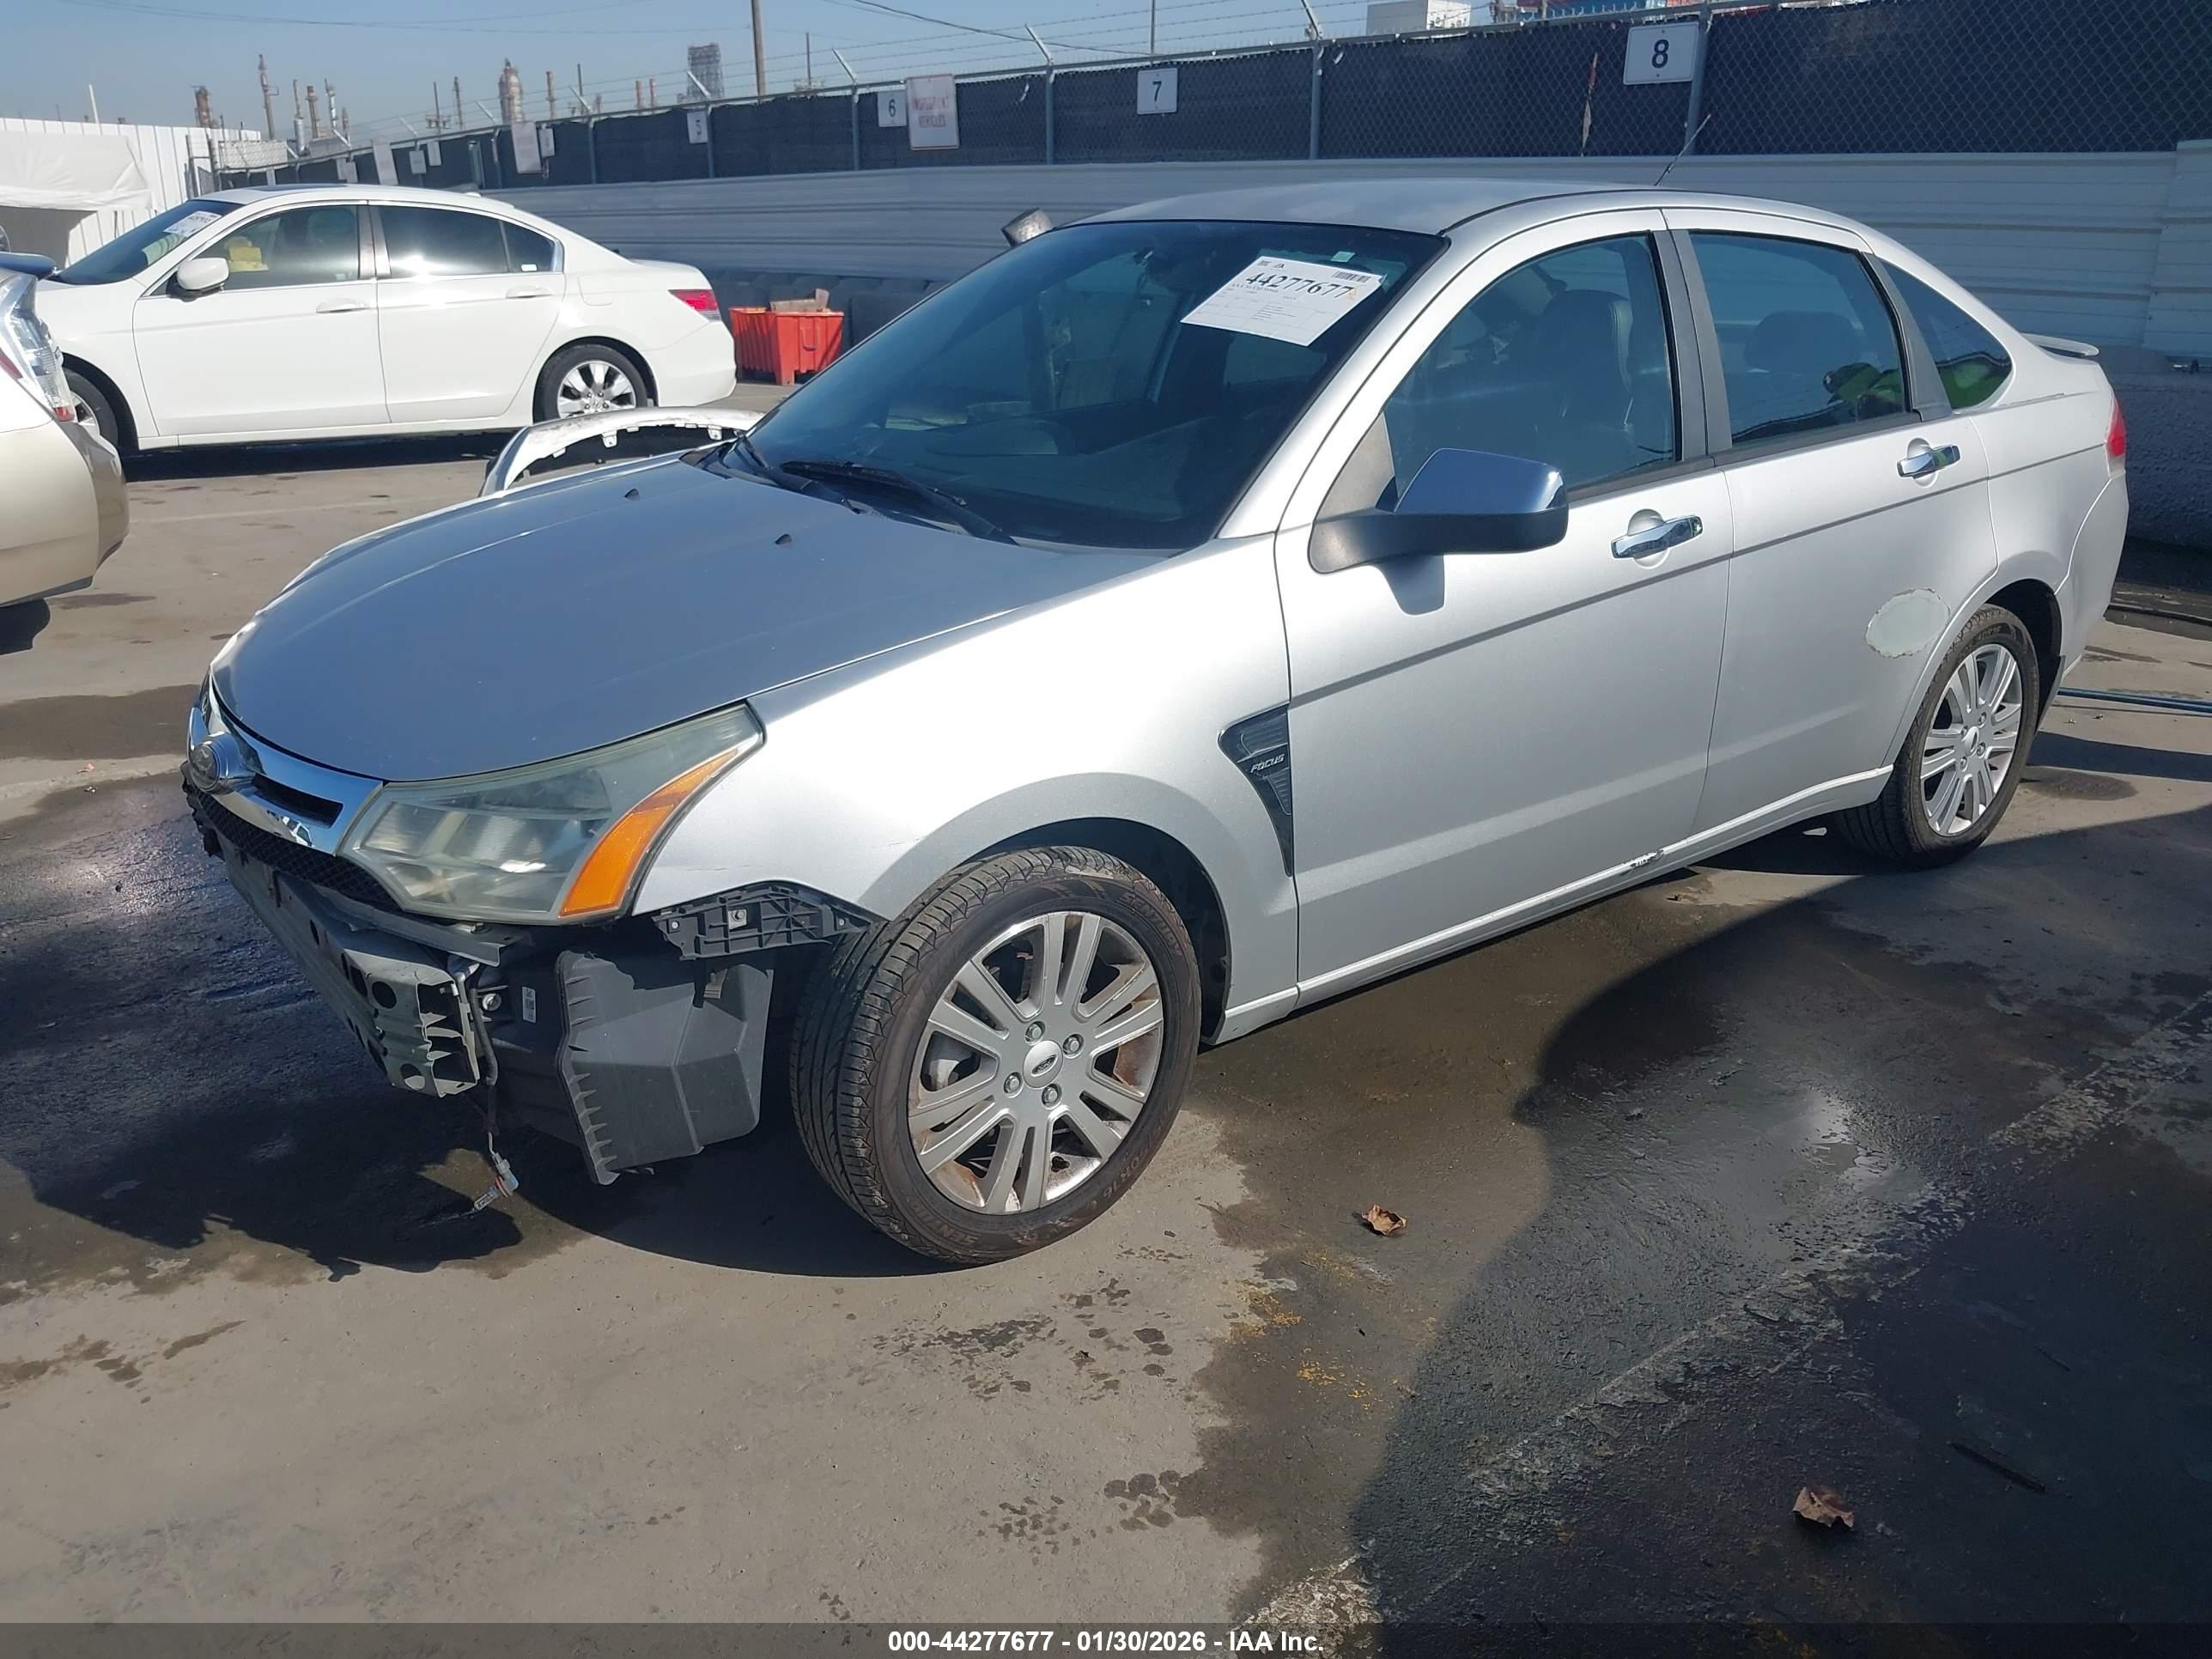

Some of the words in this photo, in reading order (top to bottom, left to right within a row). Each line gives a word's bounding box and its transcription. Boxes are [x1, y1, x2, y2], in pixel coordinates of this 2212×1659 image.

[1651, 39, 1669, 69] 8
[1152, 81, 1162, 102] 7
[888, 99, 896, 118] 6
[1245, 272, 1355, 299] 44277677
[1250, 753, 1285, 773] FOCUS
